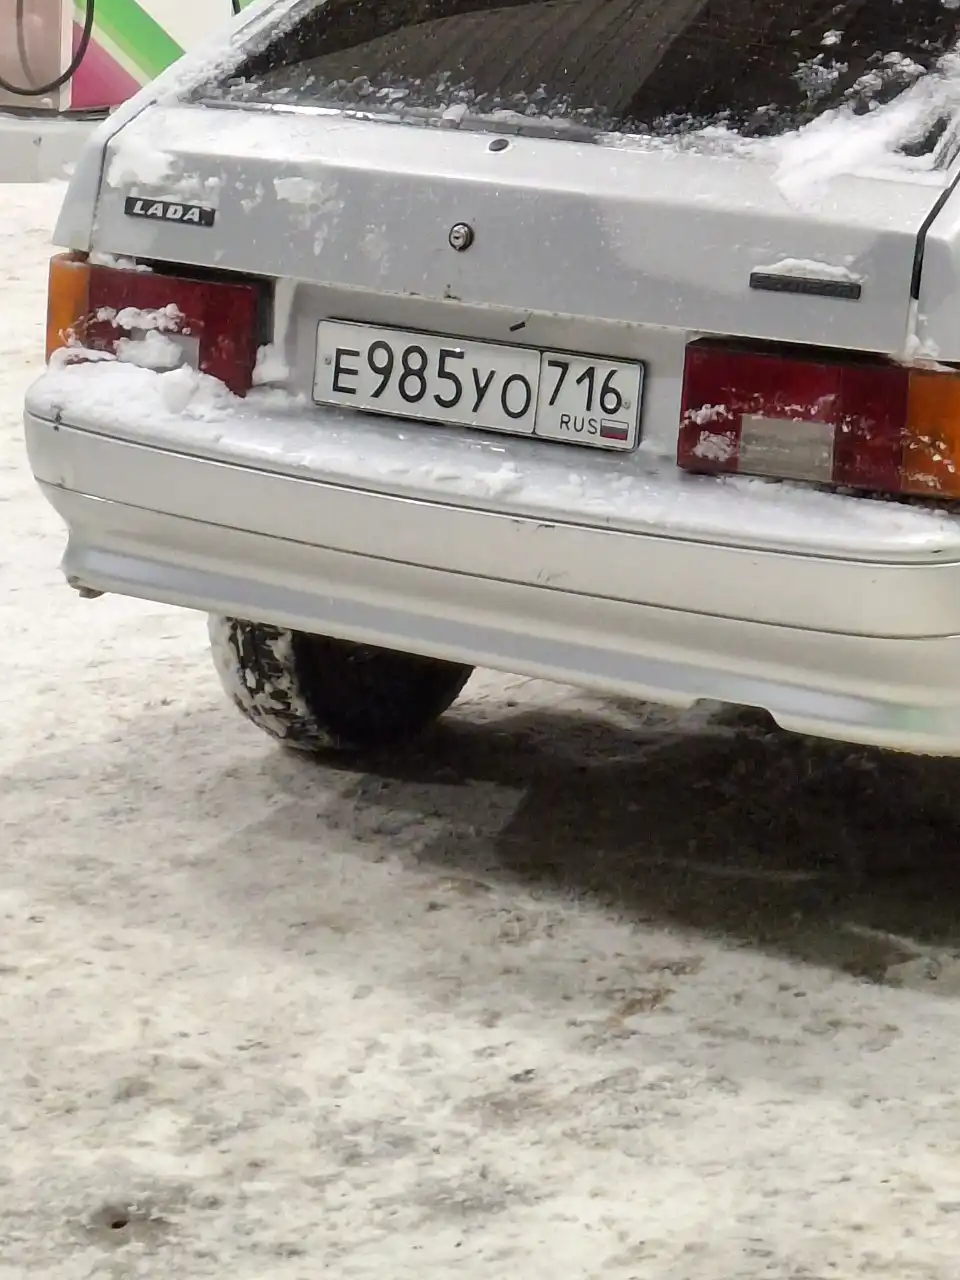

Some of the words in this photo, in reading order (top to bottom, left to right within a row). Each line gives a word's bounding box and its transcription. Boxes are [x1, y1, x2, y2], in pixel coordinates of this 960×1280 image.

[133, 200, 200, 222] LADA
[332, 340, 532, 419] Е985УО
[547, 360, 622, 415] 716
[559, 413, 598, 435] RUS
